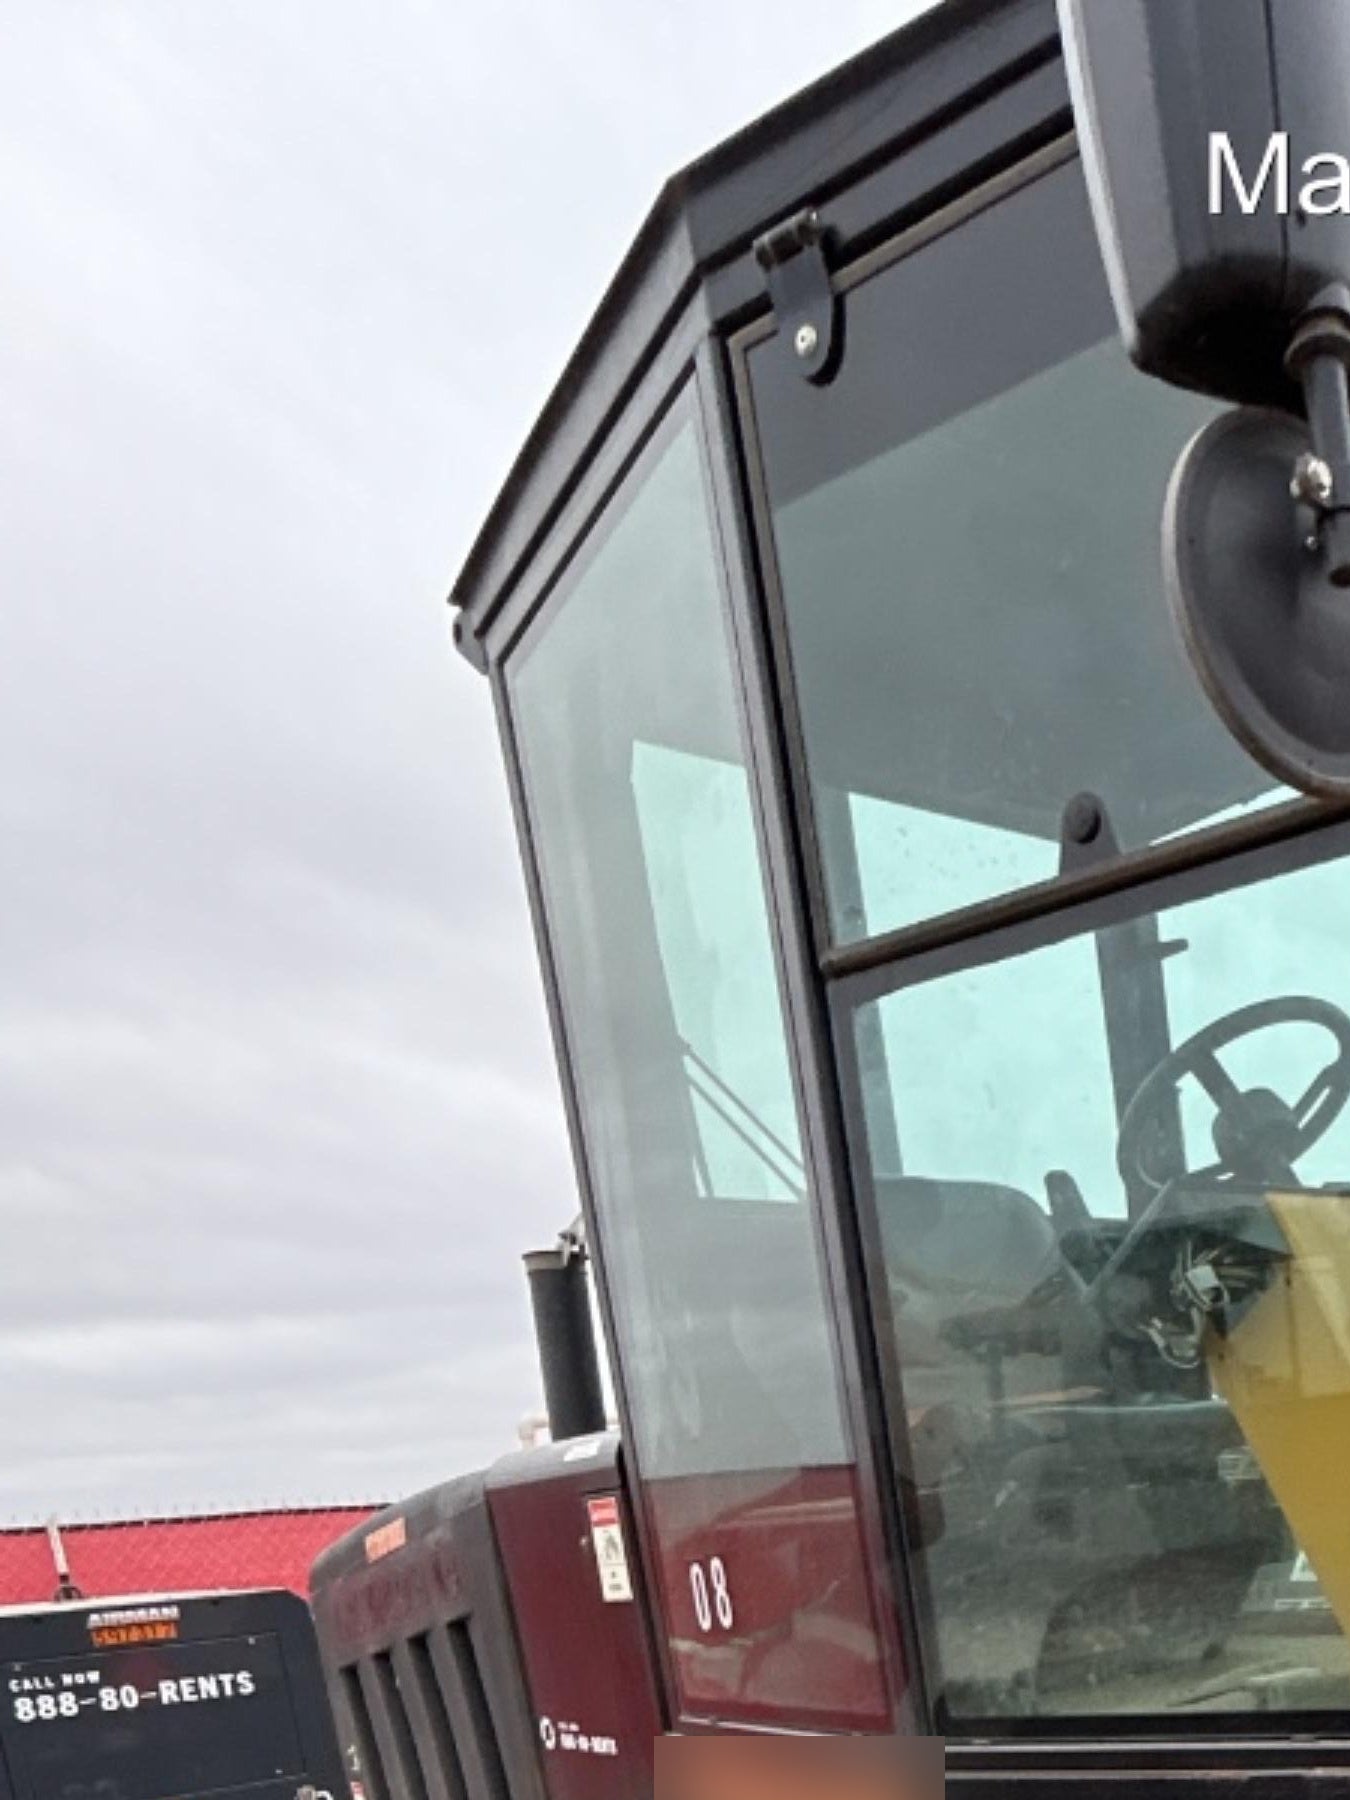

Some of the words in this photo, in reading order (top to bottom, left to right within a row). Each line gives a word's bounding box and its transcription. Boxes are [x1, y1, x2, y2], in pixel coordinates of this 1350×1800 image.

[689, 1556, 733, 1632] 08
[9, 1675, 55, 1693] CALL
[13, 1670, 257, 1723] 888-80-RENTS
